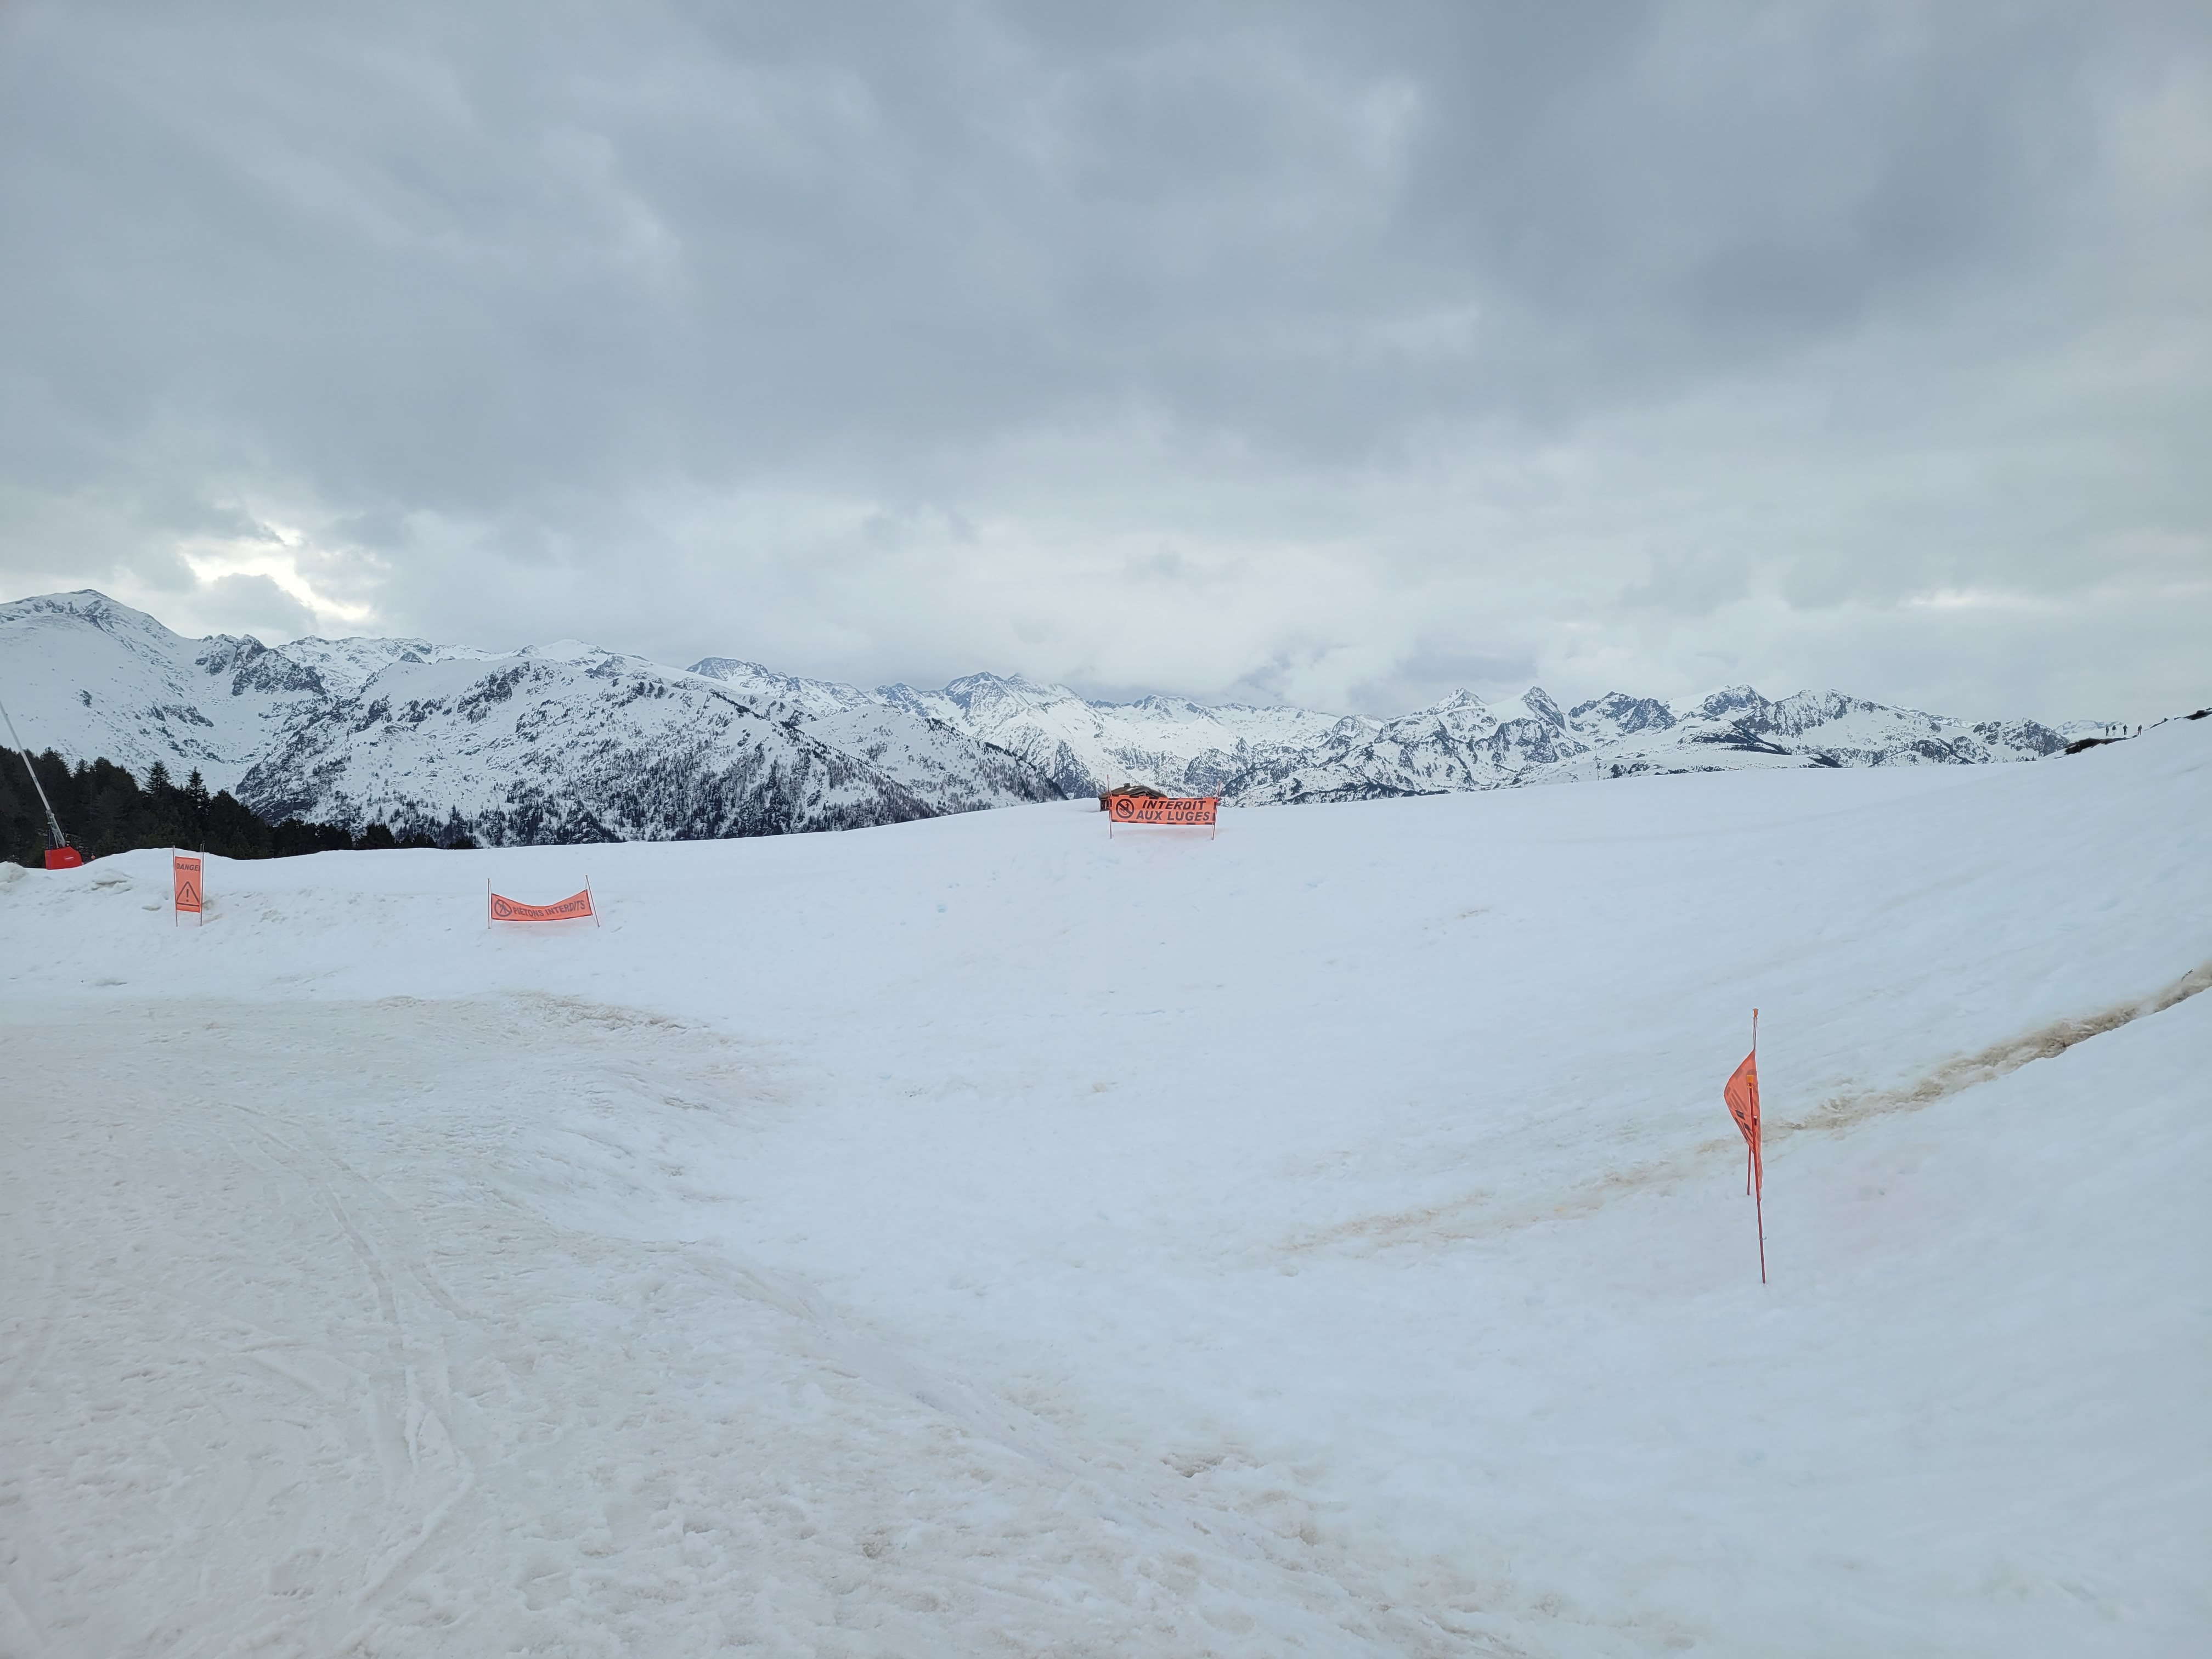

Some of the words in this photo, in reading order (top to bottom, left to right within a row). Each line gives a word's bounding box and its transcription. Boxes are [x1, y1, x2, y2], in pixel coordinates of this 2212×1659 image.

[1142, 799, 1206, 810] INTERDIT
[1136, 810, 1164, 820] AUX
[1167, 811, 1211, 821] LUGES
[176, 863, 201, 871] DANGE
[546, 900, 585, 916] INTERDITS
